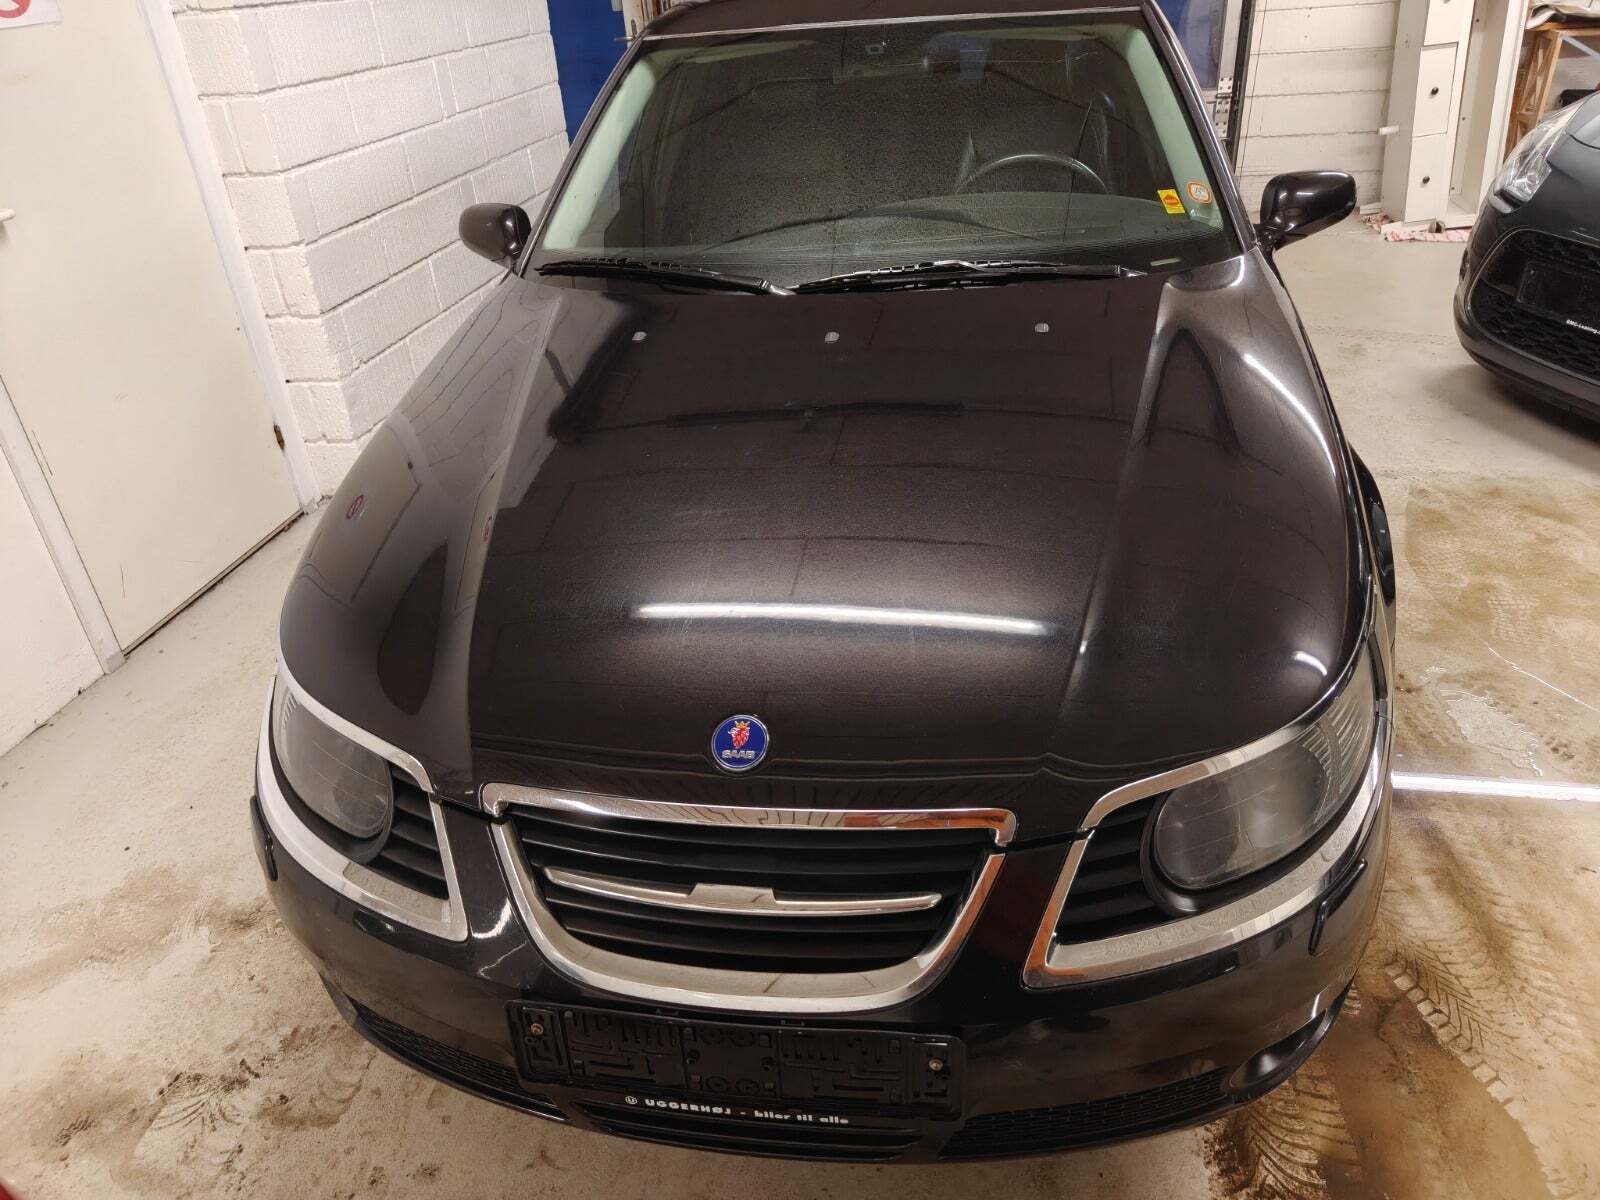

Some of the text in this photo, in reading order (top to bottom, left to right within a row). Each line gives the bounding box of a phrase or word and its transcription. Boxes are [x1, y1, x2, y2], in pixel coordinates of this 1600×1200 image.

[721, 749, 756, 759] SAAB
[644, 1098, 732, 1115] UGGERHØJ
[753, 1110, 791, 1120] biler
[796, 1114, 814, 1122] til
[819, 1116, 849, 1124] alle
